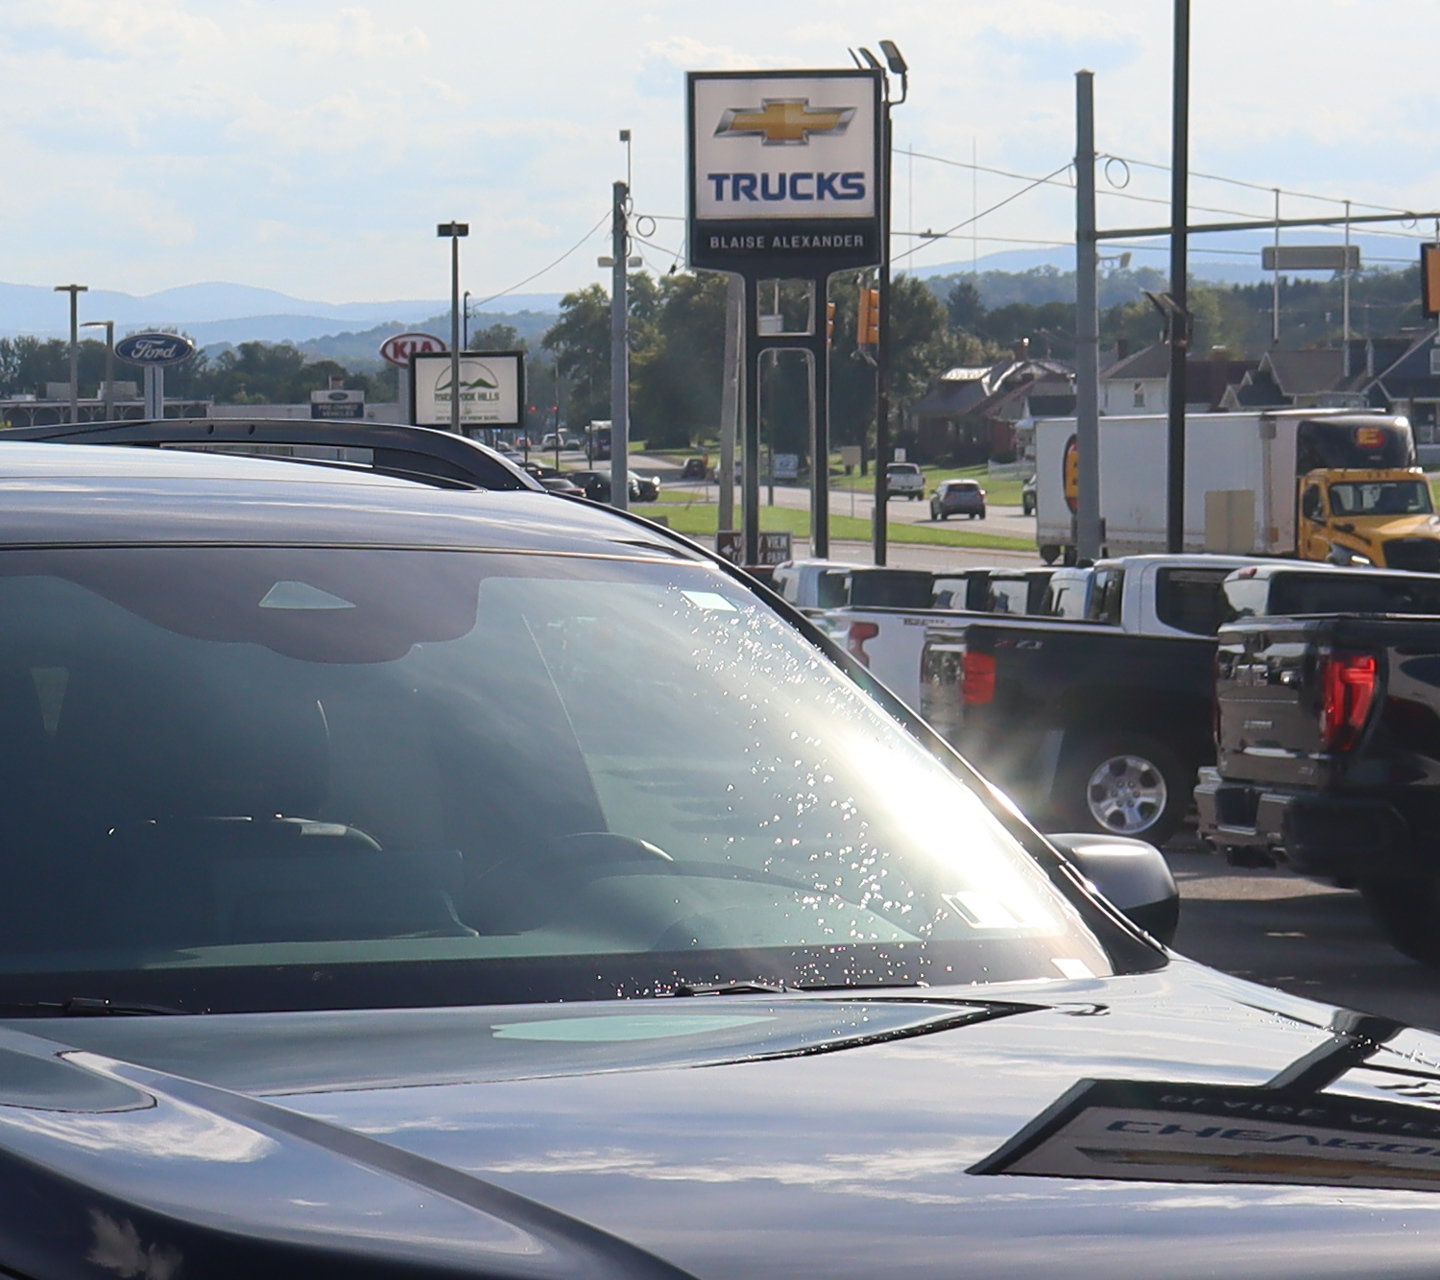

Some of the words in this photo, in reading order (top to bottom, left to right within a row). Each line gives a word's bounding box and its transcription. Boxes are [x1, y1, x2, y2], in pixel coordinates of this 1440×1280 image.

[707, 172, 866, 201] TRUCKS
[710, 236, 765, 249] BLAISE
[772, 235, 864, 248] ALEXANDER
[131, 339, 177, 359] Ford
[392, 341, 434, 359] KIA
